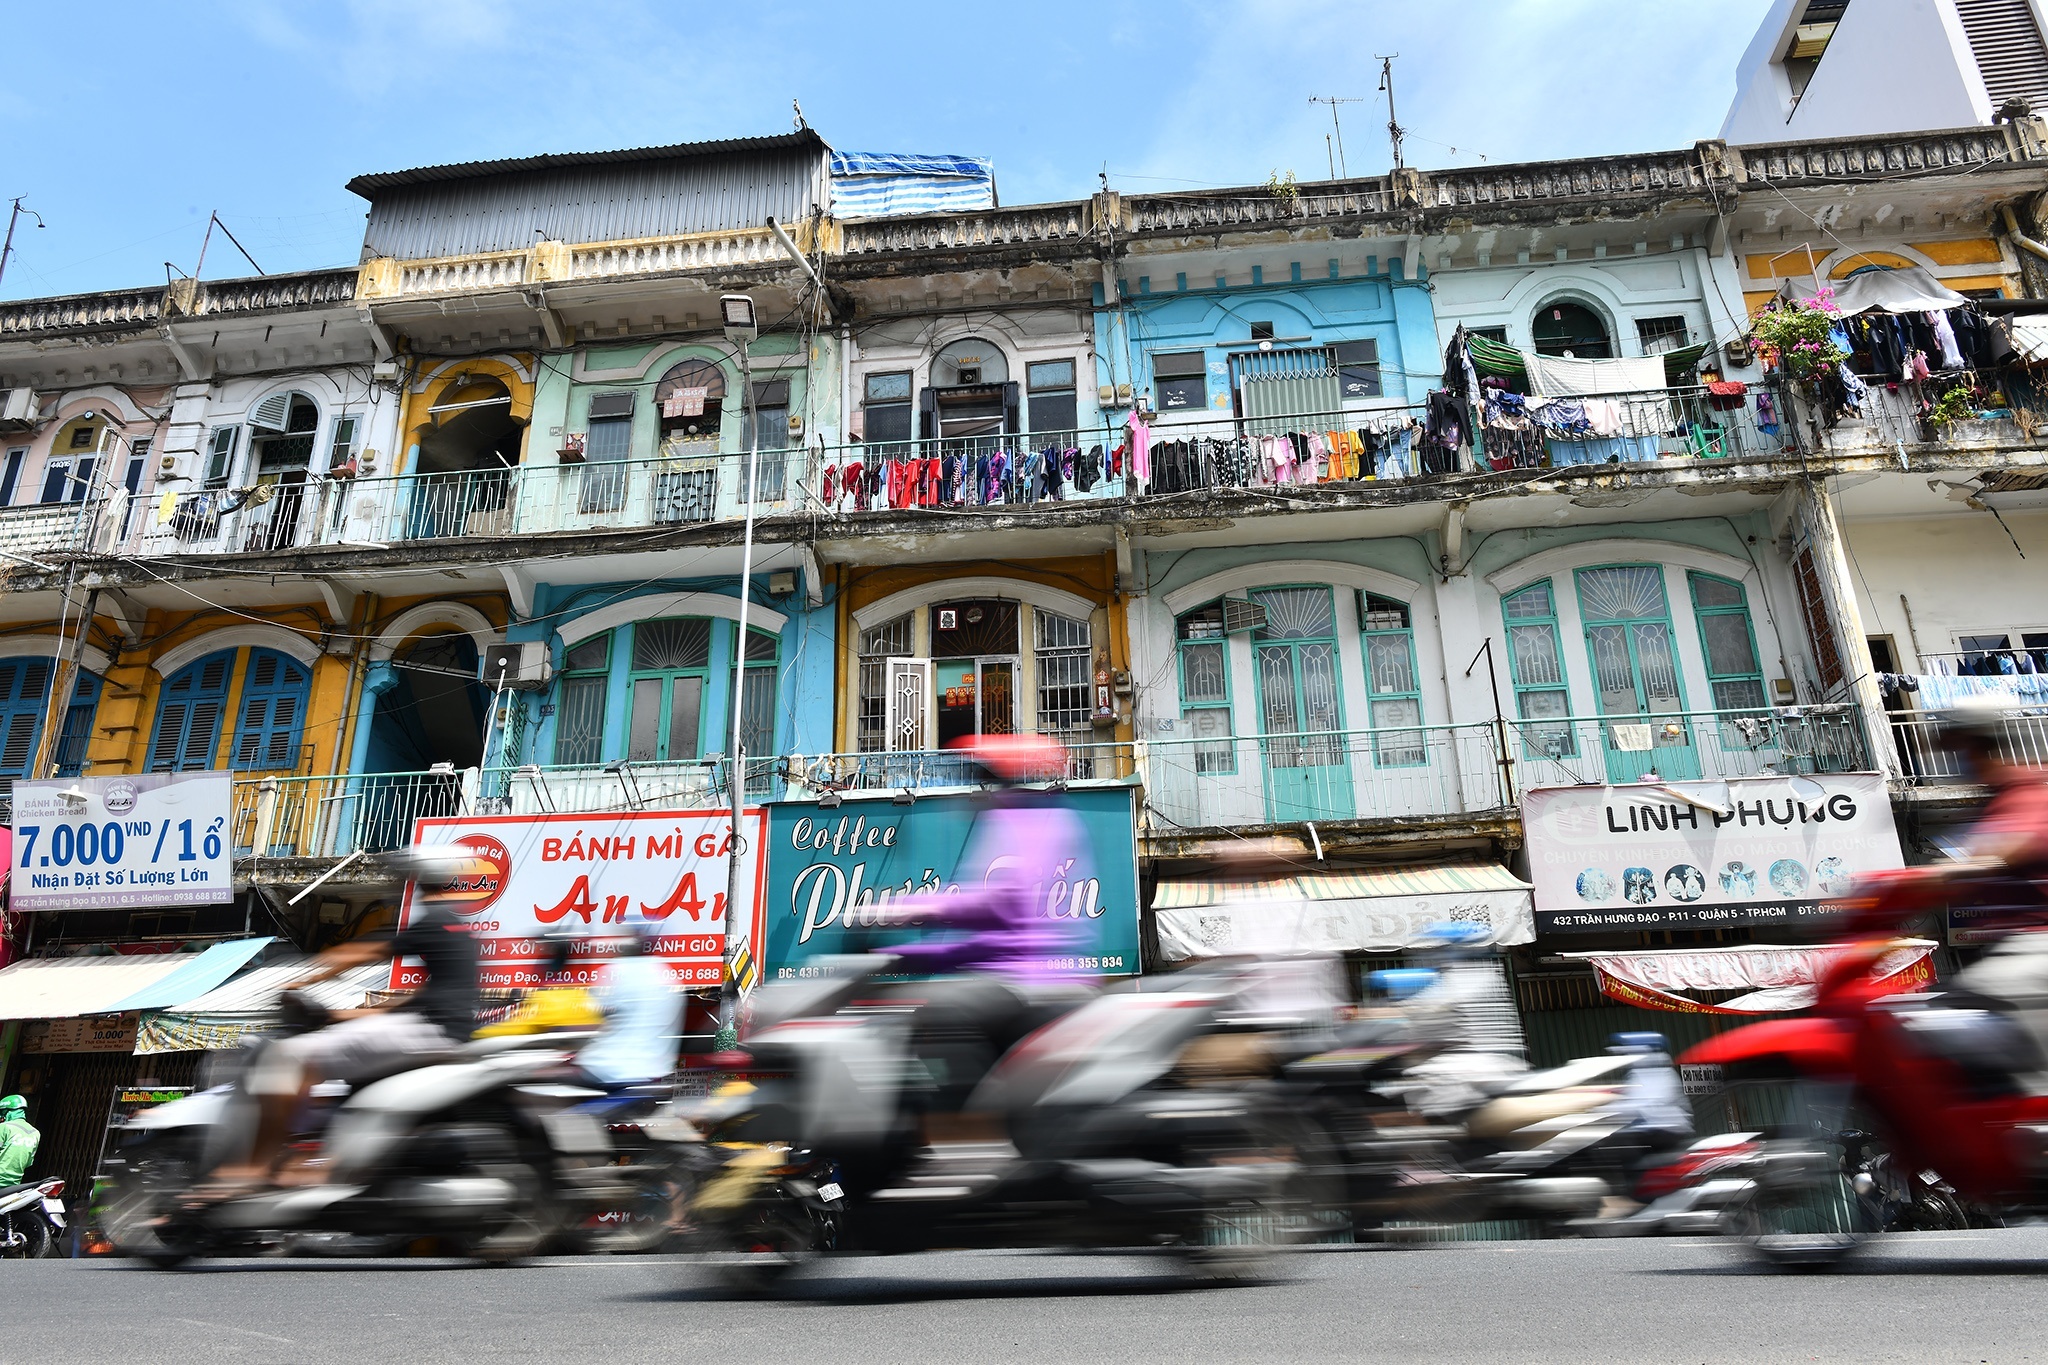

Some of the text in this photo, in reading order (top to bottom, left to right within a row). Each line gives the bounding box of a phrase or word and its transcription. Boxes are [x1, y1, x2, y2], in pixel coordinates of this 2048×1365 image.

[24, 798, 50, 808] BÁNH
[17, 807, 88, 818] (Chicken Bread)
[1605, 803, 1699, 833] LINH
[791, 814, 897, 856] Coffee
[18, 821, 124, 868] 7.000
[541, 829, 636, 861] BÁNH
[646, 827, 683, 859] MÌ
[1543, 849, 1610, 865] CHUYÊN
[1614, 848, 1654, 863] KINH
[1659, 845, 1717, 861] DOANH
[1722, 842, 1746, 857] ÁO
[1750, 840, 1788, 857] MÃO
[1832, 834, 1879, 851] CÚNG
[476, 845, 489, 856] MÌ
[489, 848, 504, 861] GÀ
[31, 867, 209, 890] Nhận Đặt Số Lượng Lớn
[442, 874, 498, 891] An An
[14, 899, 28, 908] 442
[49, 898, 70, 908] Hưng
[72, 897, 89, 907] Đạo
[121, 895, 135, 903] Q.5
[141, 894, 172, 903] Hotline:
[174, 892, 193, 902] 0938
[195, 892, 210, 900] 688
[212, 891, 227, 900] 822
[533, 874, 630, 925] An
[1553, 915, 1572, 926] 432
[1574, 912, 1602, 925] TRẦN
[1604, 913, 1635, 924] HƯNG
[1637, 912, 1660, 924] ĐẠO
[1668, 911, 1689, 921] P.11
[1698, 909, 1729, 921] QUẬN
[1731, 909, 1738, 918] 5
[1746, 906, 1787, 918] TP.HCM
[1797, 905, 1816, 915] ĐT:
[480, 940, 497, 956] MÌ
[510, 938, 536, 955] XÔI
[642, 937, 686, 954] BÁNH
[689, 935, 717, 952] GIÒ
[1078, 957, 1099, 969] 355
[401, 973, 422, 984] ĐC:
[479, 971, 511, 985] Hưng
[514, 971, 541, 985] Đạo,
[544, 970, 574, 984] P.10,
[577, 970, 598, 984] Q.5
[663, 968, 693, 981] 0938
[696, 968, 720, 980] 688
[778, 966, 796, 979] ĐC:
[798, 966, 819, 978] 436
[93, 1030, 123, 1040] 10.000
